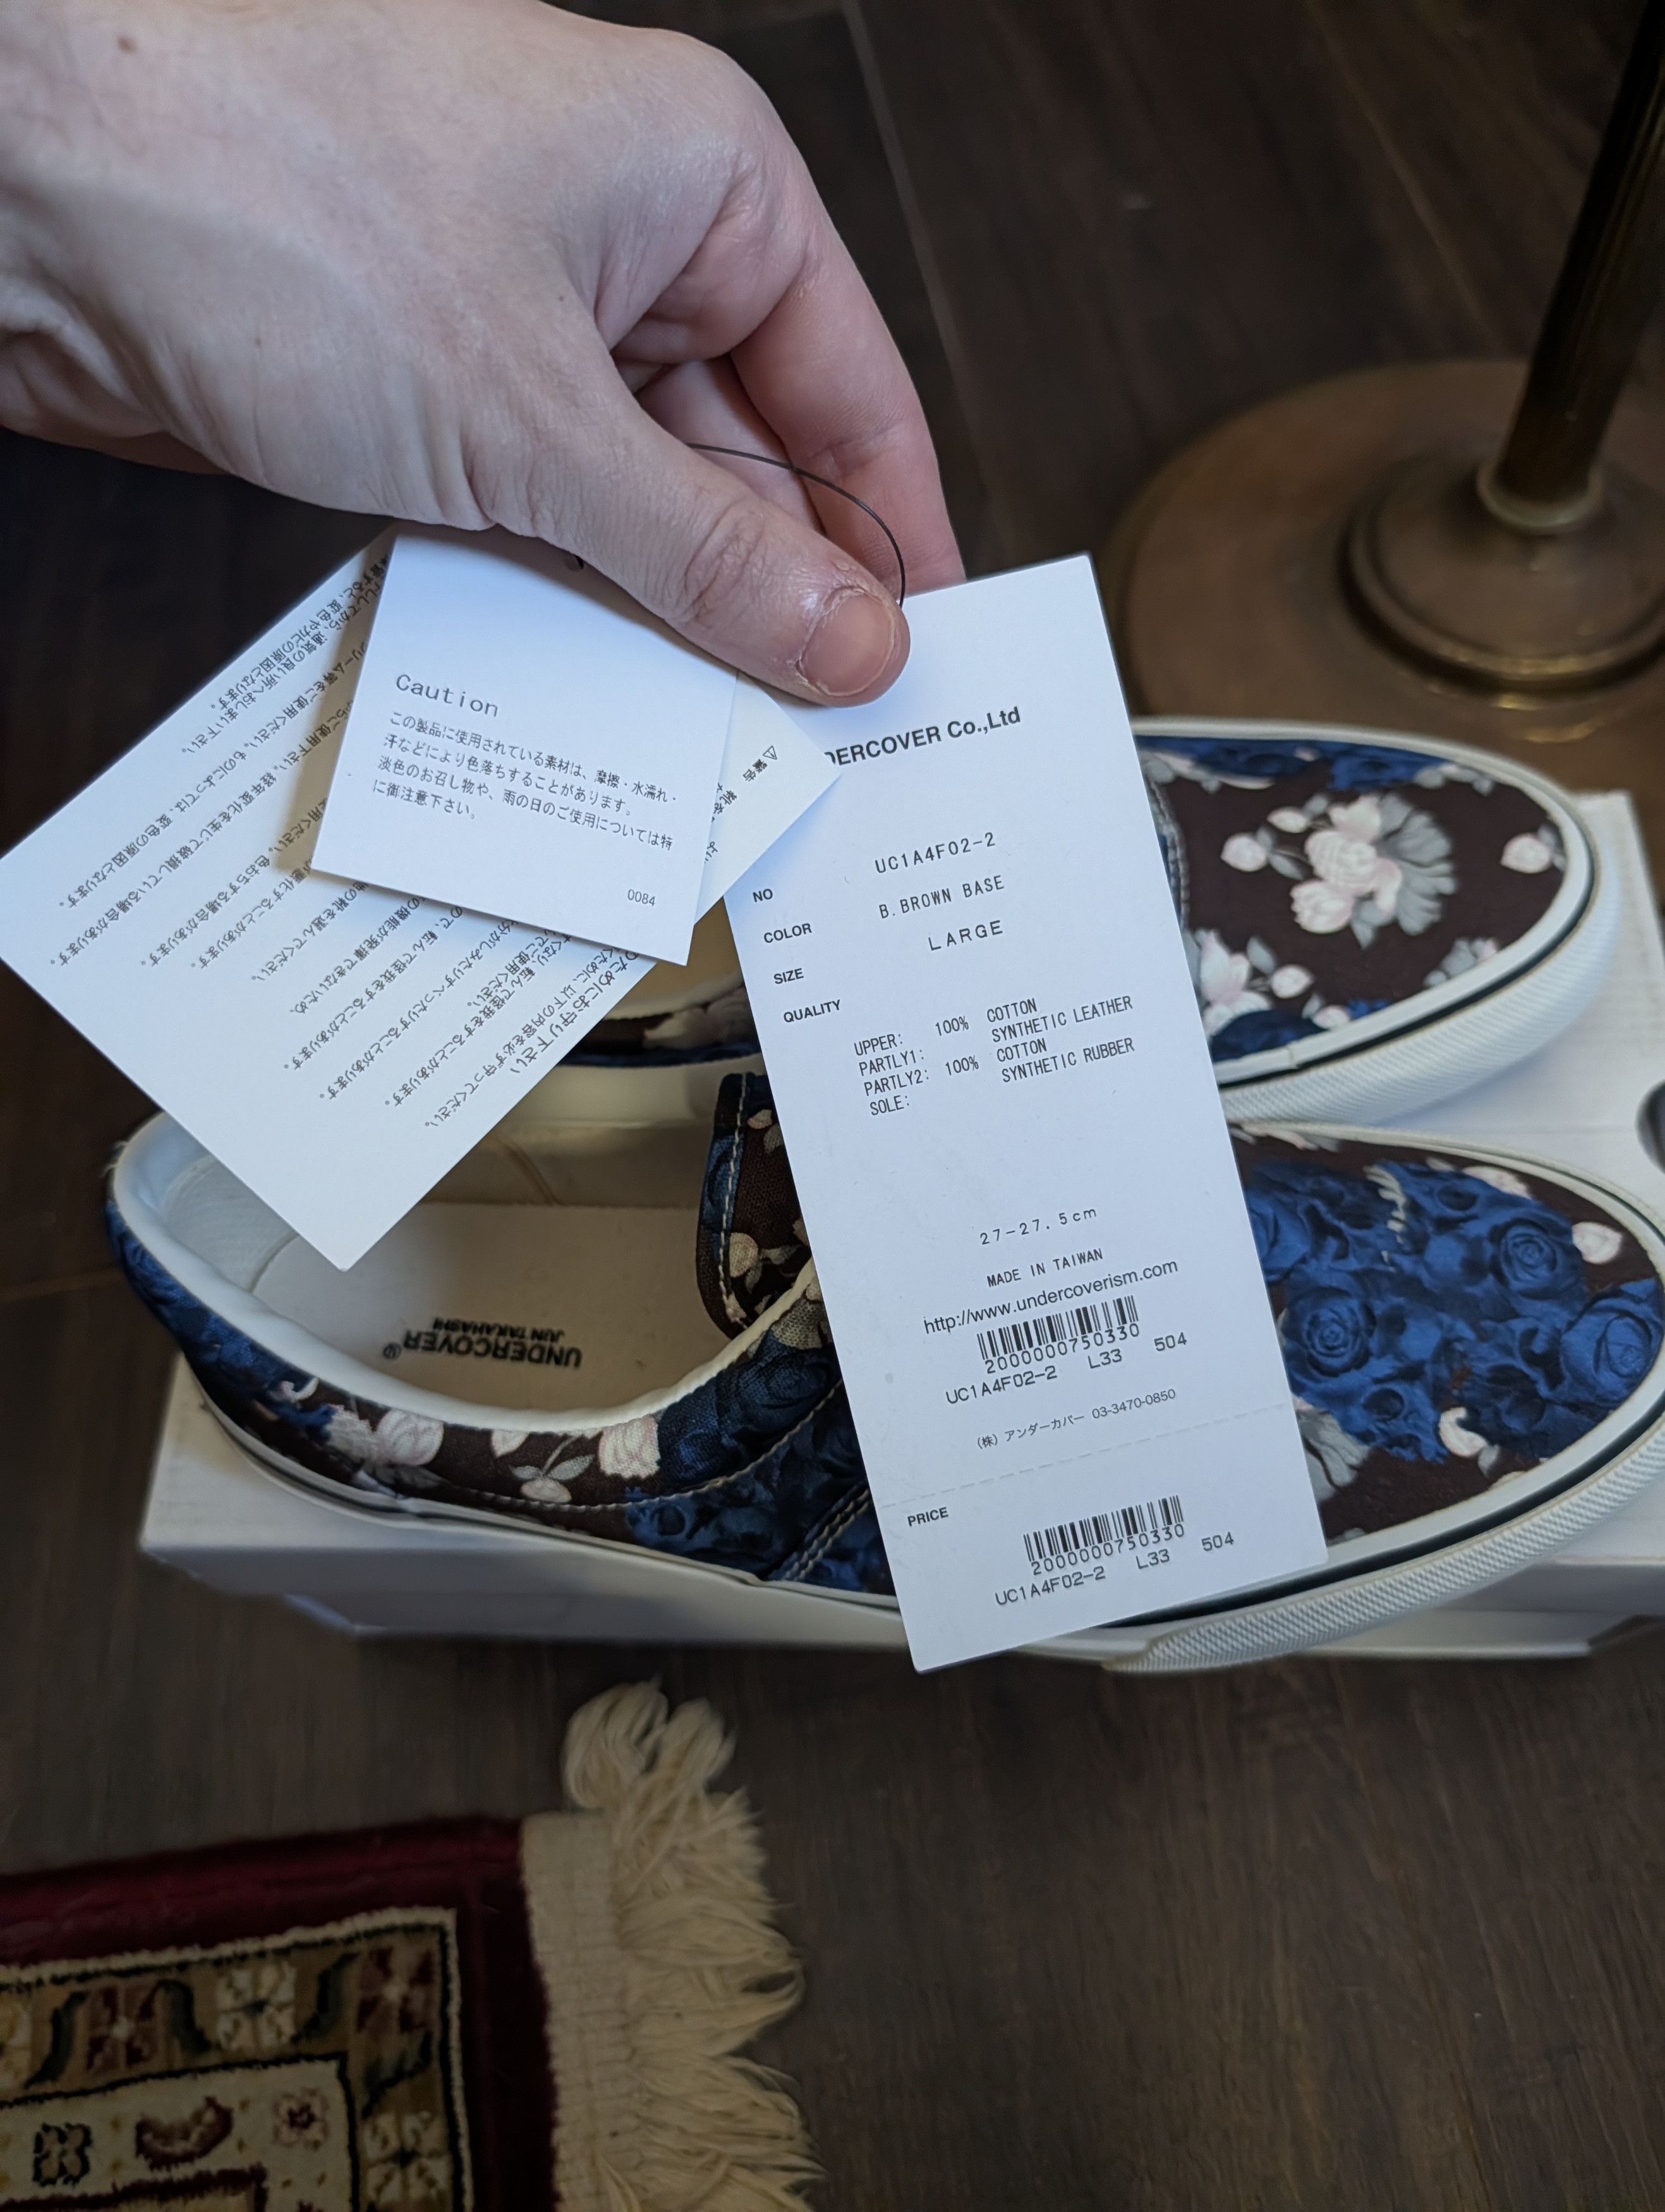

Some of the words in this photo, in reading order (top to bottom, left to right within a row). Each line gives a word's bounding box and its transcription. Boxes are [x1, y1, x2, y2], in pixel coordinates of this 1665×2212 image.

[396, 673, 499, 717] Caution
[947, 705, 1021, 739] Co.,Ltd
[372, 779, 475, 820] に御注意下さい。
[377, 755, 673, 851] 淡色のお召し物や、雨の日のご使用については特
[383, 733, 631, 817] 汗などにより色落ちすることがあります。
[752, 888, 774, 903] NO
[874, 831, 996, 874] UC1A4F02-2
[627, 889, 656, 907] 0084
[763, 922, 813, 944] COLOR
[961, 874, 1005, 899] BASE
[773, 967, 805, 985] SIZE
[928, 919, 1003, 952] LARGE
[425, 944, 624, 1127] くために、以下の内容を必ず守ってください。
[783, 999, 841, 1023] QUALITY
[853, 1033, 903, 1057] UPPER:
[935, 1015, 969, 1036] 100%
[986, 997, 1038, 1023] COTTON
[858, 1049, 924, 1077] PARTLY1:
[991, 1011, 1067, 1043] SYNTHETIC
[1072, 995, 1134, 1024] LEATHER
[863, 1068, 929, 1097] PARTLY2:
[945, 1054, 980, 1076] 100%
[996, 1037, 1048, 1063] COTTON
[869, 1094, 910, 1116] SOLE:
[1001, 1051, 1077, 1083] SYNTHETIC
[1082, 1037, 1135, 1064] RUBBER
[923, 1261, 1178, 1335] http://www.undercoverism.com
[986, 1268, 1022, 1288] MADE
[1029, 1261, 1046, 1277] IN
[1051, 1248, 1103, 1271] TAIWAN
[945, 1364, 1058, 1405] UC1A4F02-2
[1087, 1347, 1123, 1370] L33
[1153, 1331, 1187, 1352] 504
[984, 1323, 1140, 1375] 2000000750330
[1091, 1388, 1177, 1420] 03-3470-0850
[907, 1506, 949, 1528] PRICE
[995, 1565, 1106, 1607] UC1A4F02-2
[1135, 1548, 1170, 1571] L33
[1201, 1531, 1235, 1552] 504
[1029, 1523, 1185, 1577] 2000000750330
